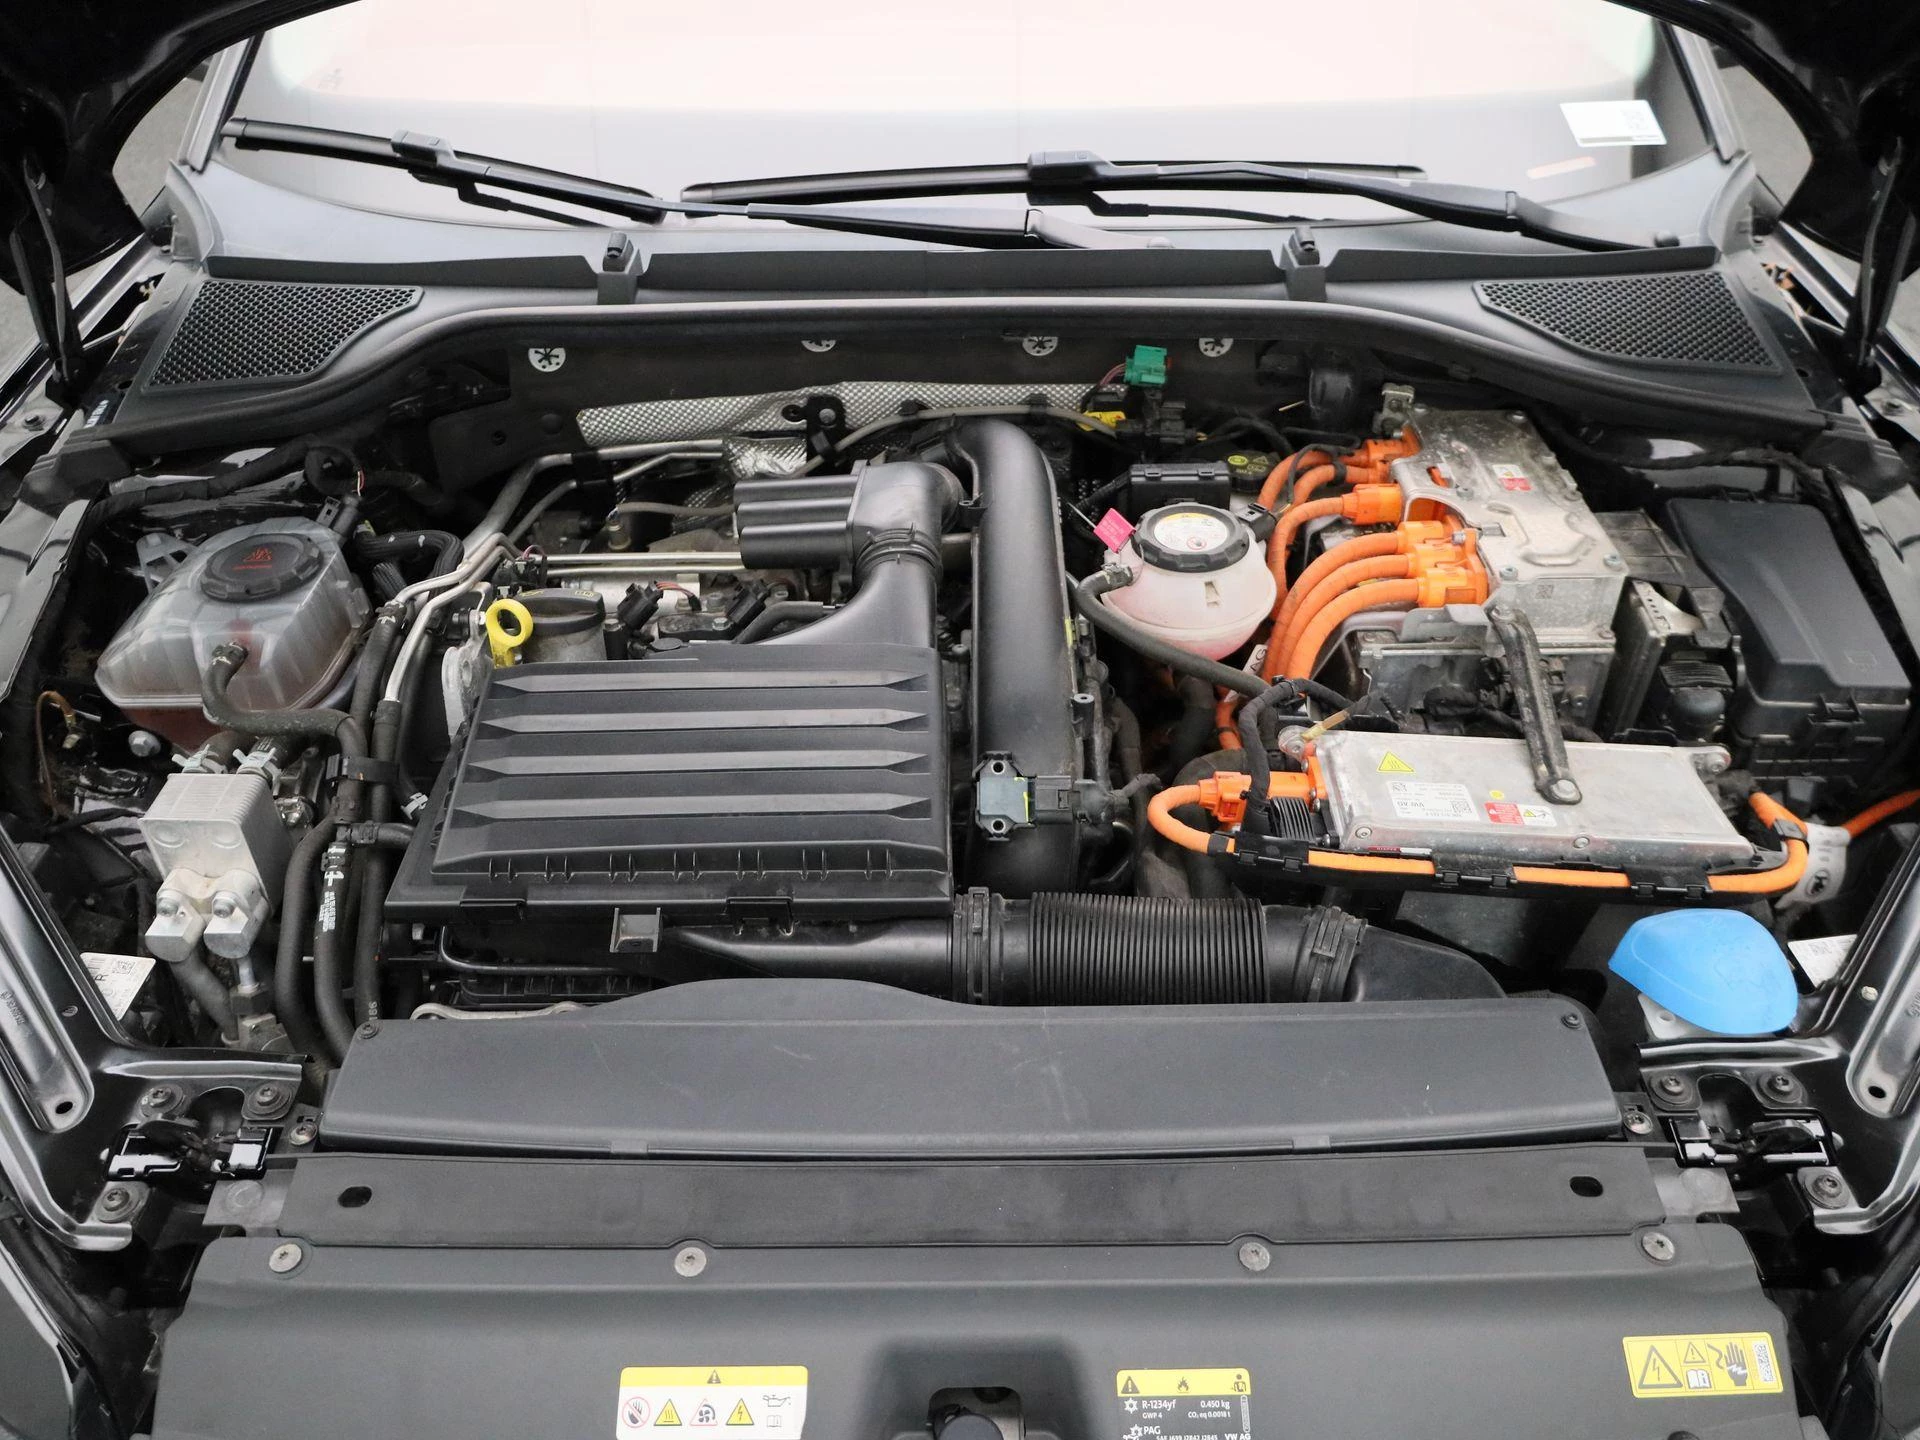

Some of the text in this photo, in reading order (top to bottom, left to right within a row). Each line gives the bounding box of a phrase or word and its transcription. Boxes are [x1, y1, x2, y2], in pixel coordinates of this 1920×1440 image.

[1141, 1399, 1176, 1411] R-1234yf
[1200, 1400, 1230, 1409] 0.450 kg
[1143, 1426, 1161, 1435] PAG
